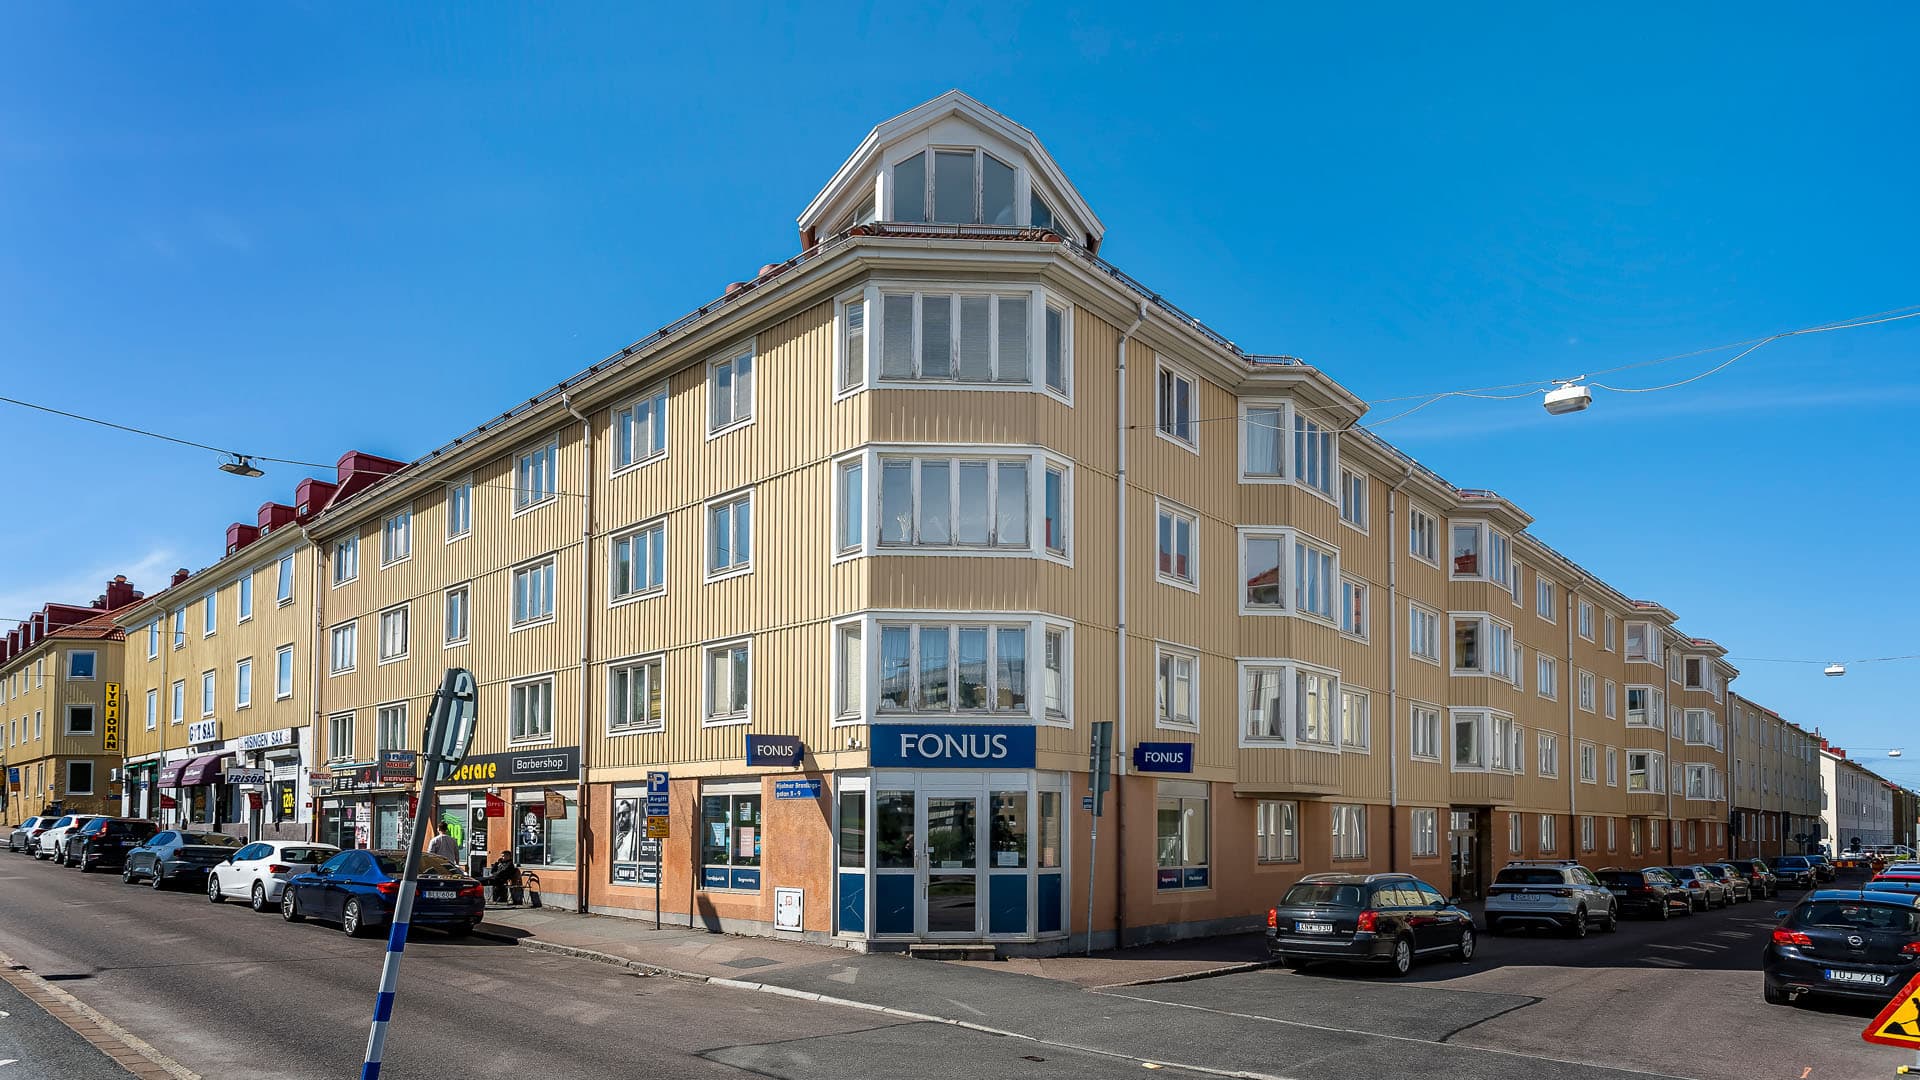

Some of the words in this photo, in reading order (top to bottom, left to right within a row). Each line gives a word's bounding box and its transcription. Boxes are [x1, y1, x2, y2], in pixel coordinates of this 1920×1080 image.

[108, 684, 117, 708] TYG
[106, 710, 117, 749] JOHAN
[244, 733, 269, 748] HISINGEN
[271, 731, 283, 745] SAX
[900, 733, 1008, 759] FONUS
[757, 745, 794, 756] FONUS
[1144, 751, 1184, 763] FONUS
[516, 758, 563, 770] Barbershop
[228, 773, 265, 783] FRISÖR
[652, 773, 666, 791] P
